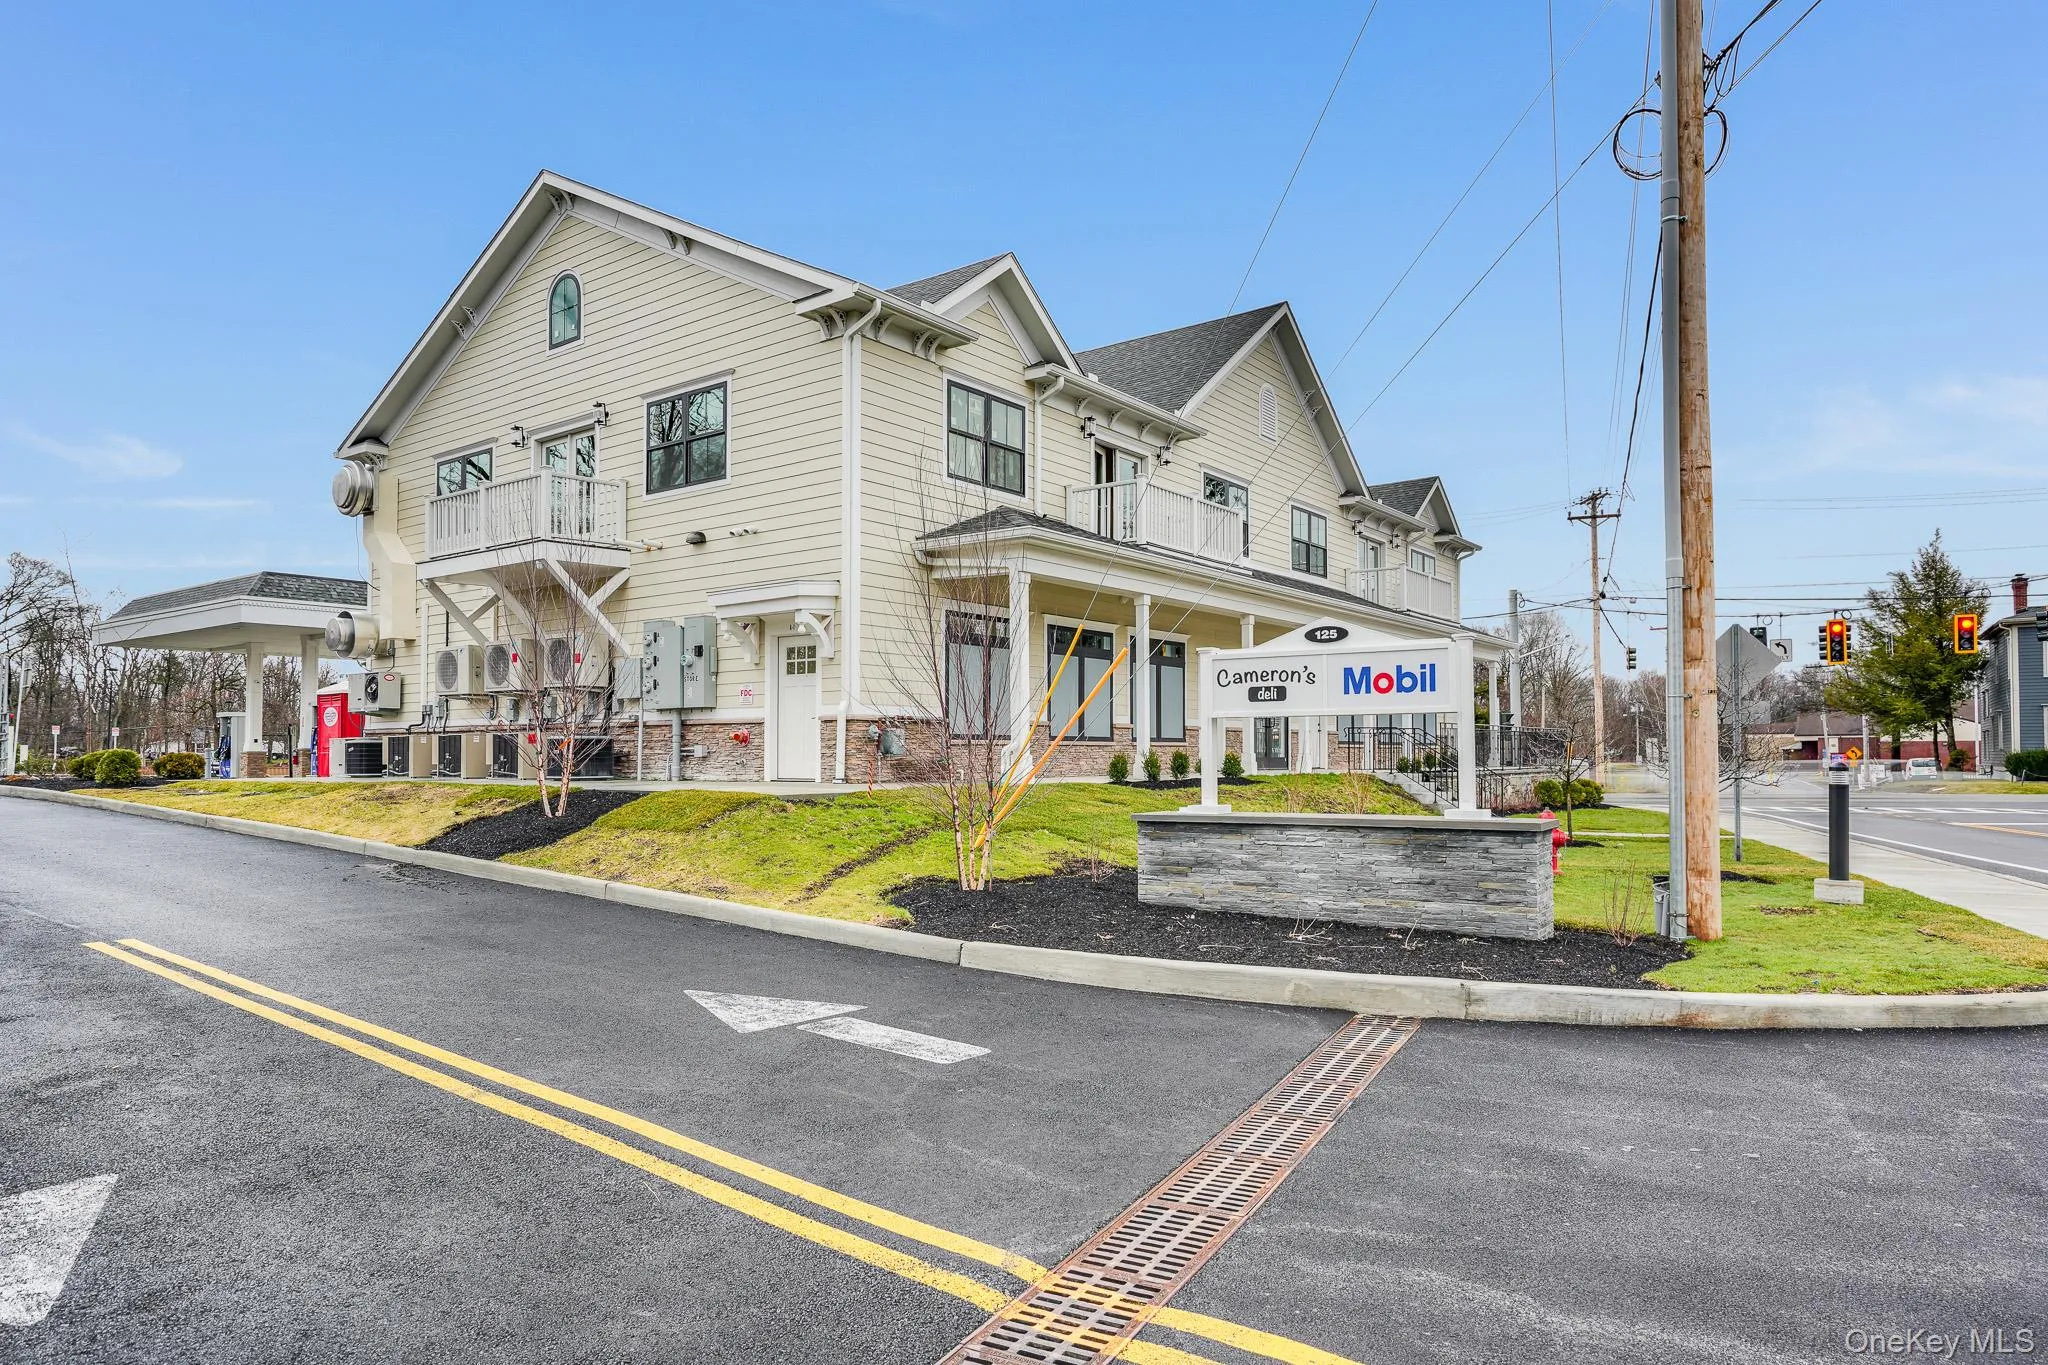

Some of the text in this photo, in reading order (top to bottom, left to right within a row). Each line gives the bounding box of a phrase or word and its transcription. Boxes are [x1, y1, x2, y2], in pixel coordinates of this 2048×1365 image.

[1315, 629, 1338, 640] 125
[1217, 665, 1316, 687] Cameron's
[1343, 663, 1436, 695] Mobil
[740, 689, 753, 697] FDC
[1257, 687, 1278, 700] deli
